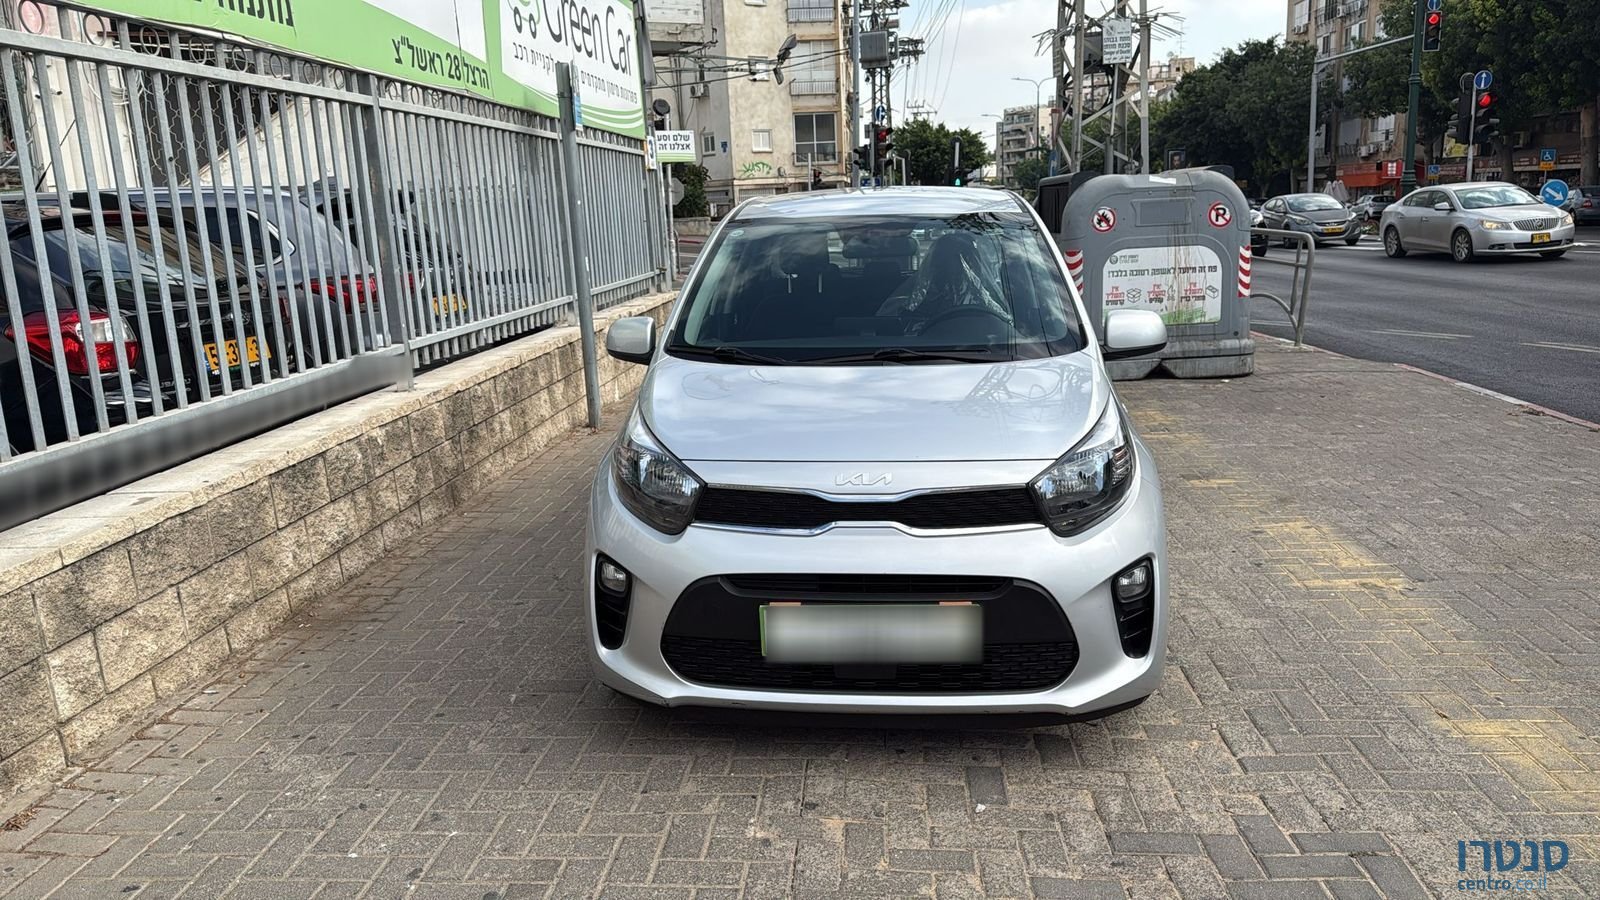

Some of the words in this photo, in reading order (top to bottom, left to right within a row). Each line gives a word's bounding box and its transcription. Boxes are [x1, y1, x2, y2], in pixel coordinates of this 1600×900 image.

[543, 0, 605, 64] Green
[606, 5, 631, 76] Car
[513, 42, 528, 62] רכב
[446, 52, 461, 81] 28
[462, 56, 490, 90] הרצל
[673, 132, 690, 141] שלם
[670, 142, 690, 150] אצלנו
[1215, 207, 1227, 222] P
[835, 472, 893, 486] KIA
